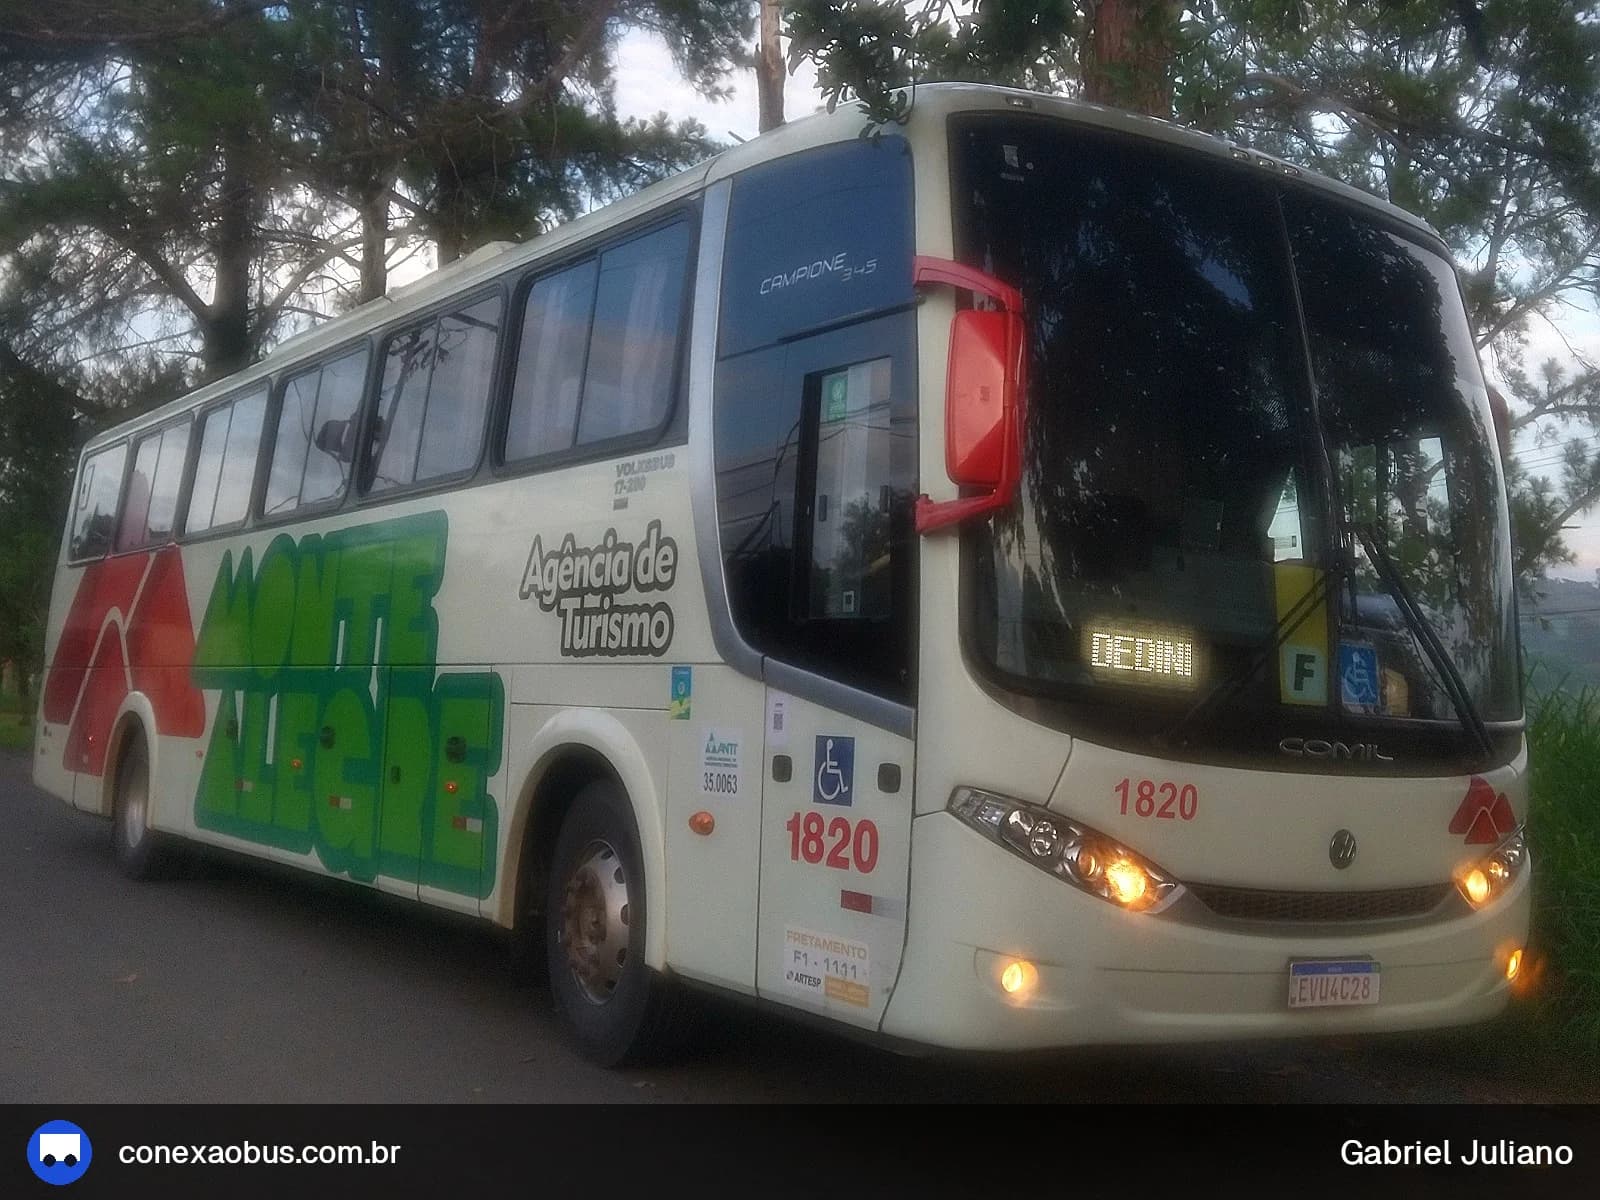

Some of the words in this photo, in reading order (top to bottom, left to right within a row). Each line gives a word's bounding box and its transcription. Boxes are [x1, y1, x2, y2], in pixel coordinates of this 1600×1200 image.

[759, 252, 847, 296] CAMPIONE
[521, 530, 632, 608] Agência
[635, 523, 676, 589] de
[194, 518, 444, 688] MONTE
[559, 597, 672, 653] Turismo
[1090, 632, 1192, 677] DEDINI
[1293, 653, 1316, 692] F
[1279, 737, 1394, 761] COMIL
[196, 680, 500, 886] ALEGRE
[703, 772, 738, 794] 35.0063
[1114, 777, 1199, 821] 1820
[786, 811, 879, 874] 1820
[785, 930, 867, 960] FRETAMENTO
[793, 949, 808, 968] F1
[823, 957, 858, 980] 1111
[794, 972, 822, 988] ARTESP
[1298, 976, 1371, 1002] EVU4C28
